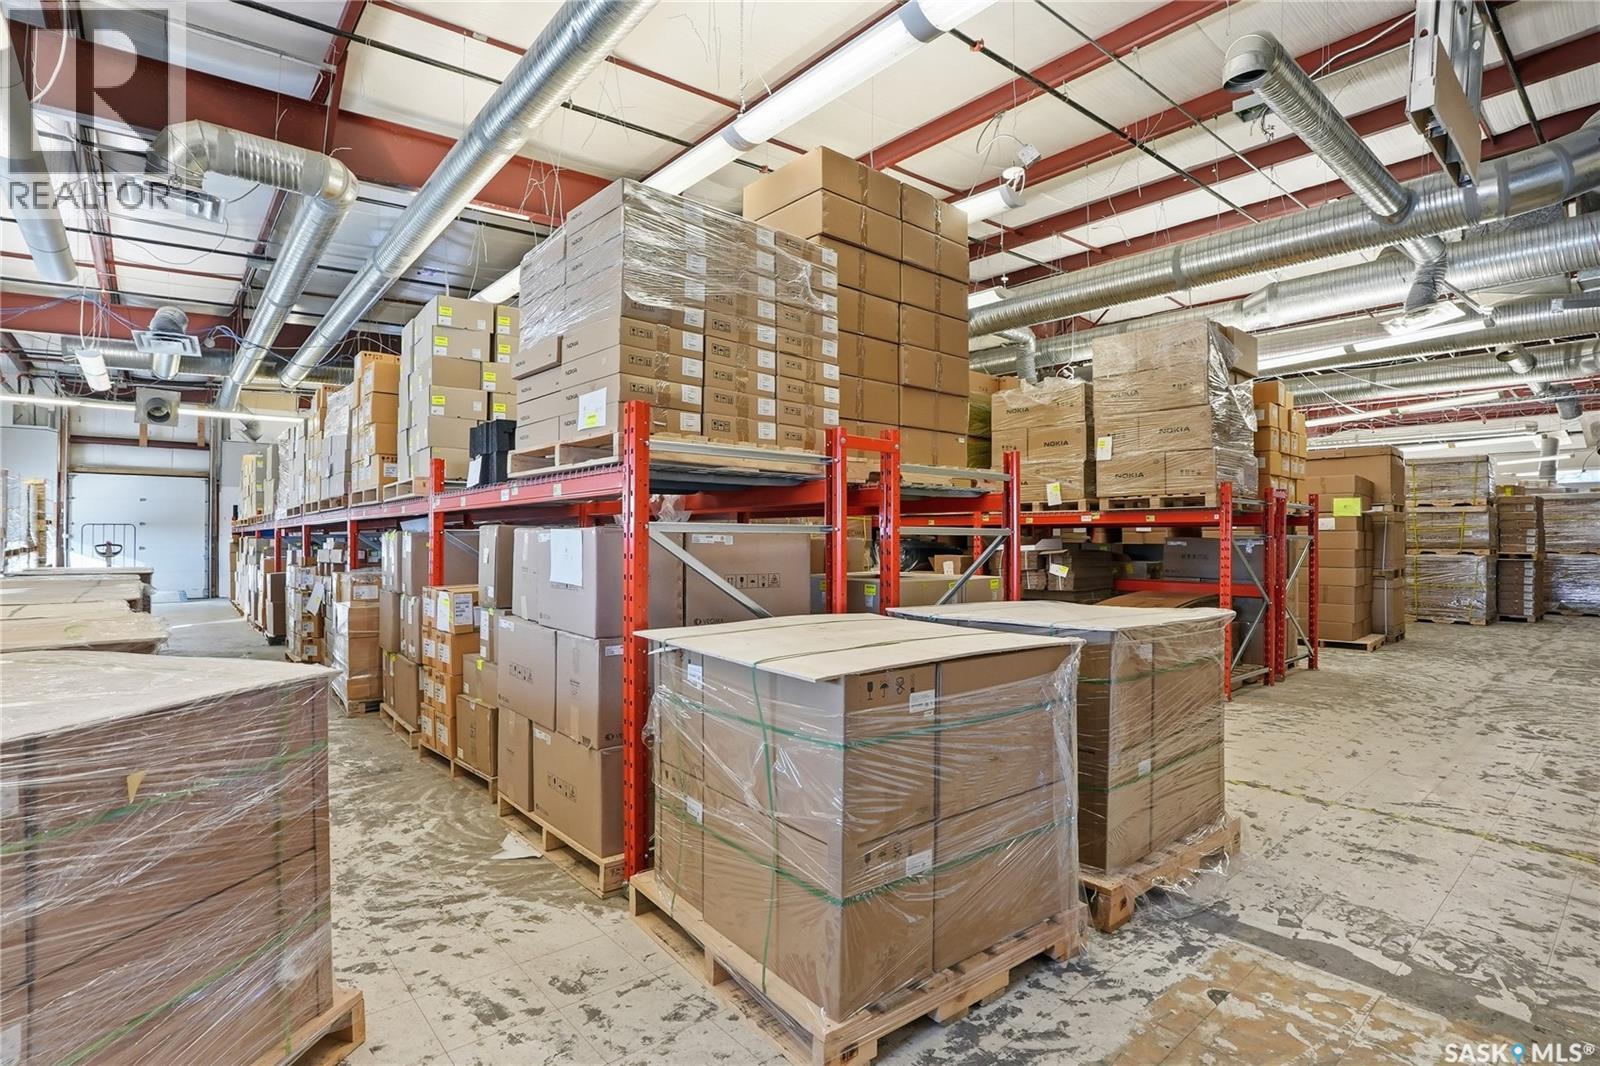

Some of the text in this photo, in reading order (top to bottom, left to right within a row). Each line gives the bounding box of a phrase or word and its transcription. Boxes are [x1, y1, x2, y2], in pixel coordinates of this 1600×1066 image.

[1005, 407, 1030, 415] NOKIA
[1158, 426, 1191, 435] NOKIA
[1043, 440, 1069, 448] NOKIA
